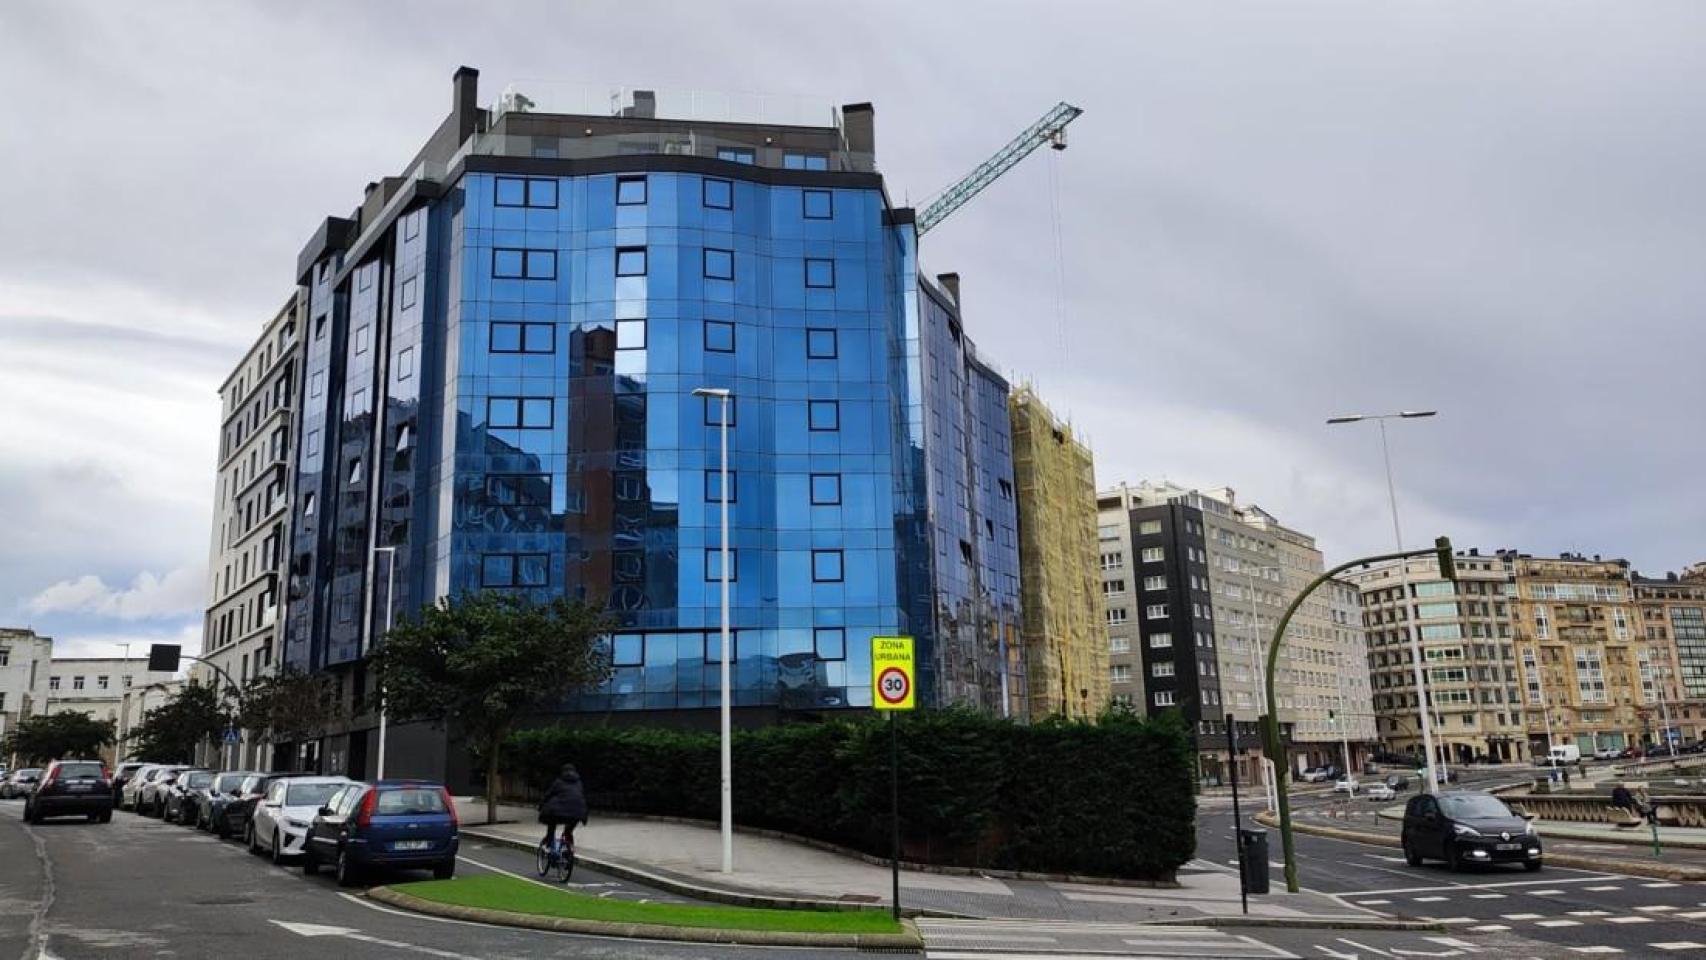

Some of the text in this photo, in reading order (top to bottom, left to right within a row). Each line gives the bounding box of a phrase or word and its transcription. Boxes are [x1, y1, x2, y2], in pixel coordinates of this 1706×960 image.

[880, 641, 905, 649] ZONA
[875, 653, 911, 661] URBANA
[885, 679, 903, 692] 30
